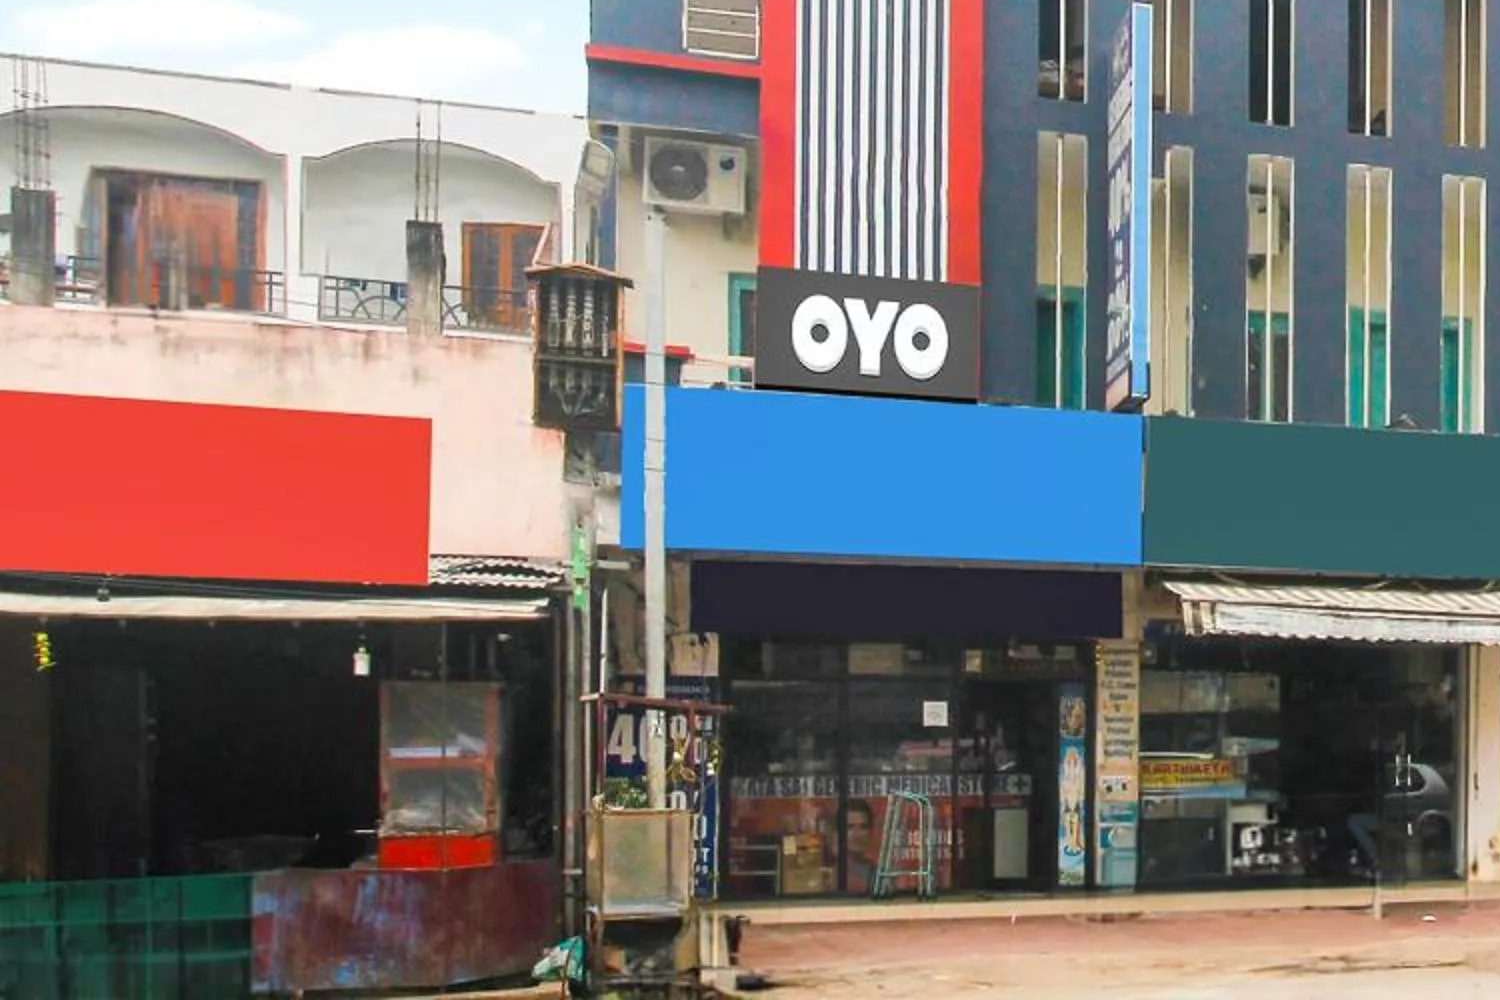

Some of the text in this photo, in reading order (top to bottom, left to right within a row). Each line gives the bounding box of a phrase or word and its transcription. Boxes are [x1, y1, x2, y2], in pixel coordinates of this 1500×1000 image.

[791, 294, 949, 380] OYO
[812, 776, 882, 797] GEERIC
[887, 776, 952, 797] MEDICA
